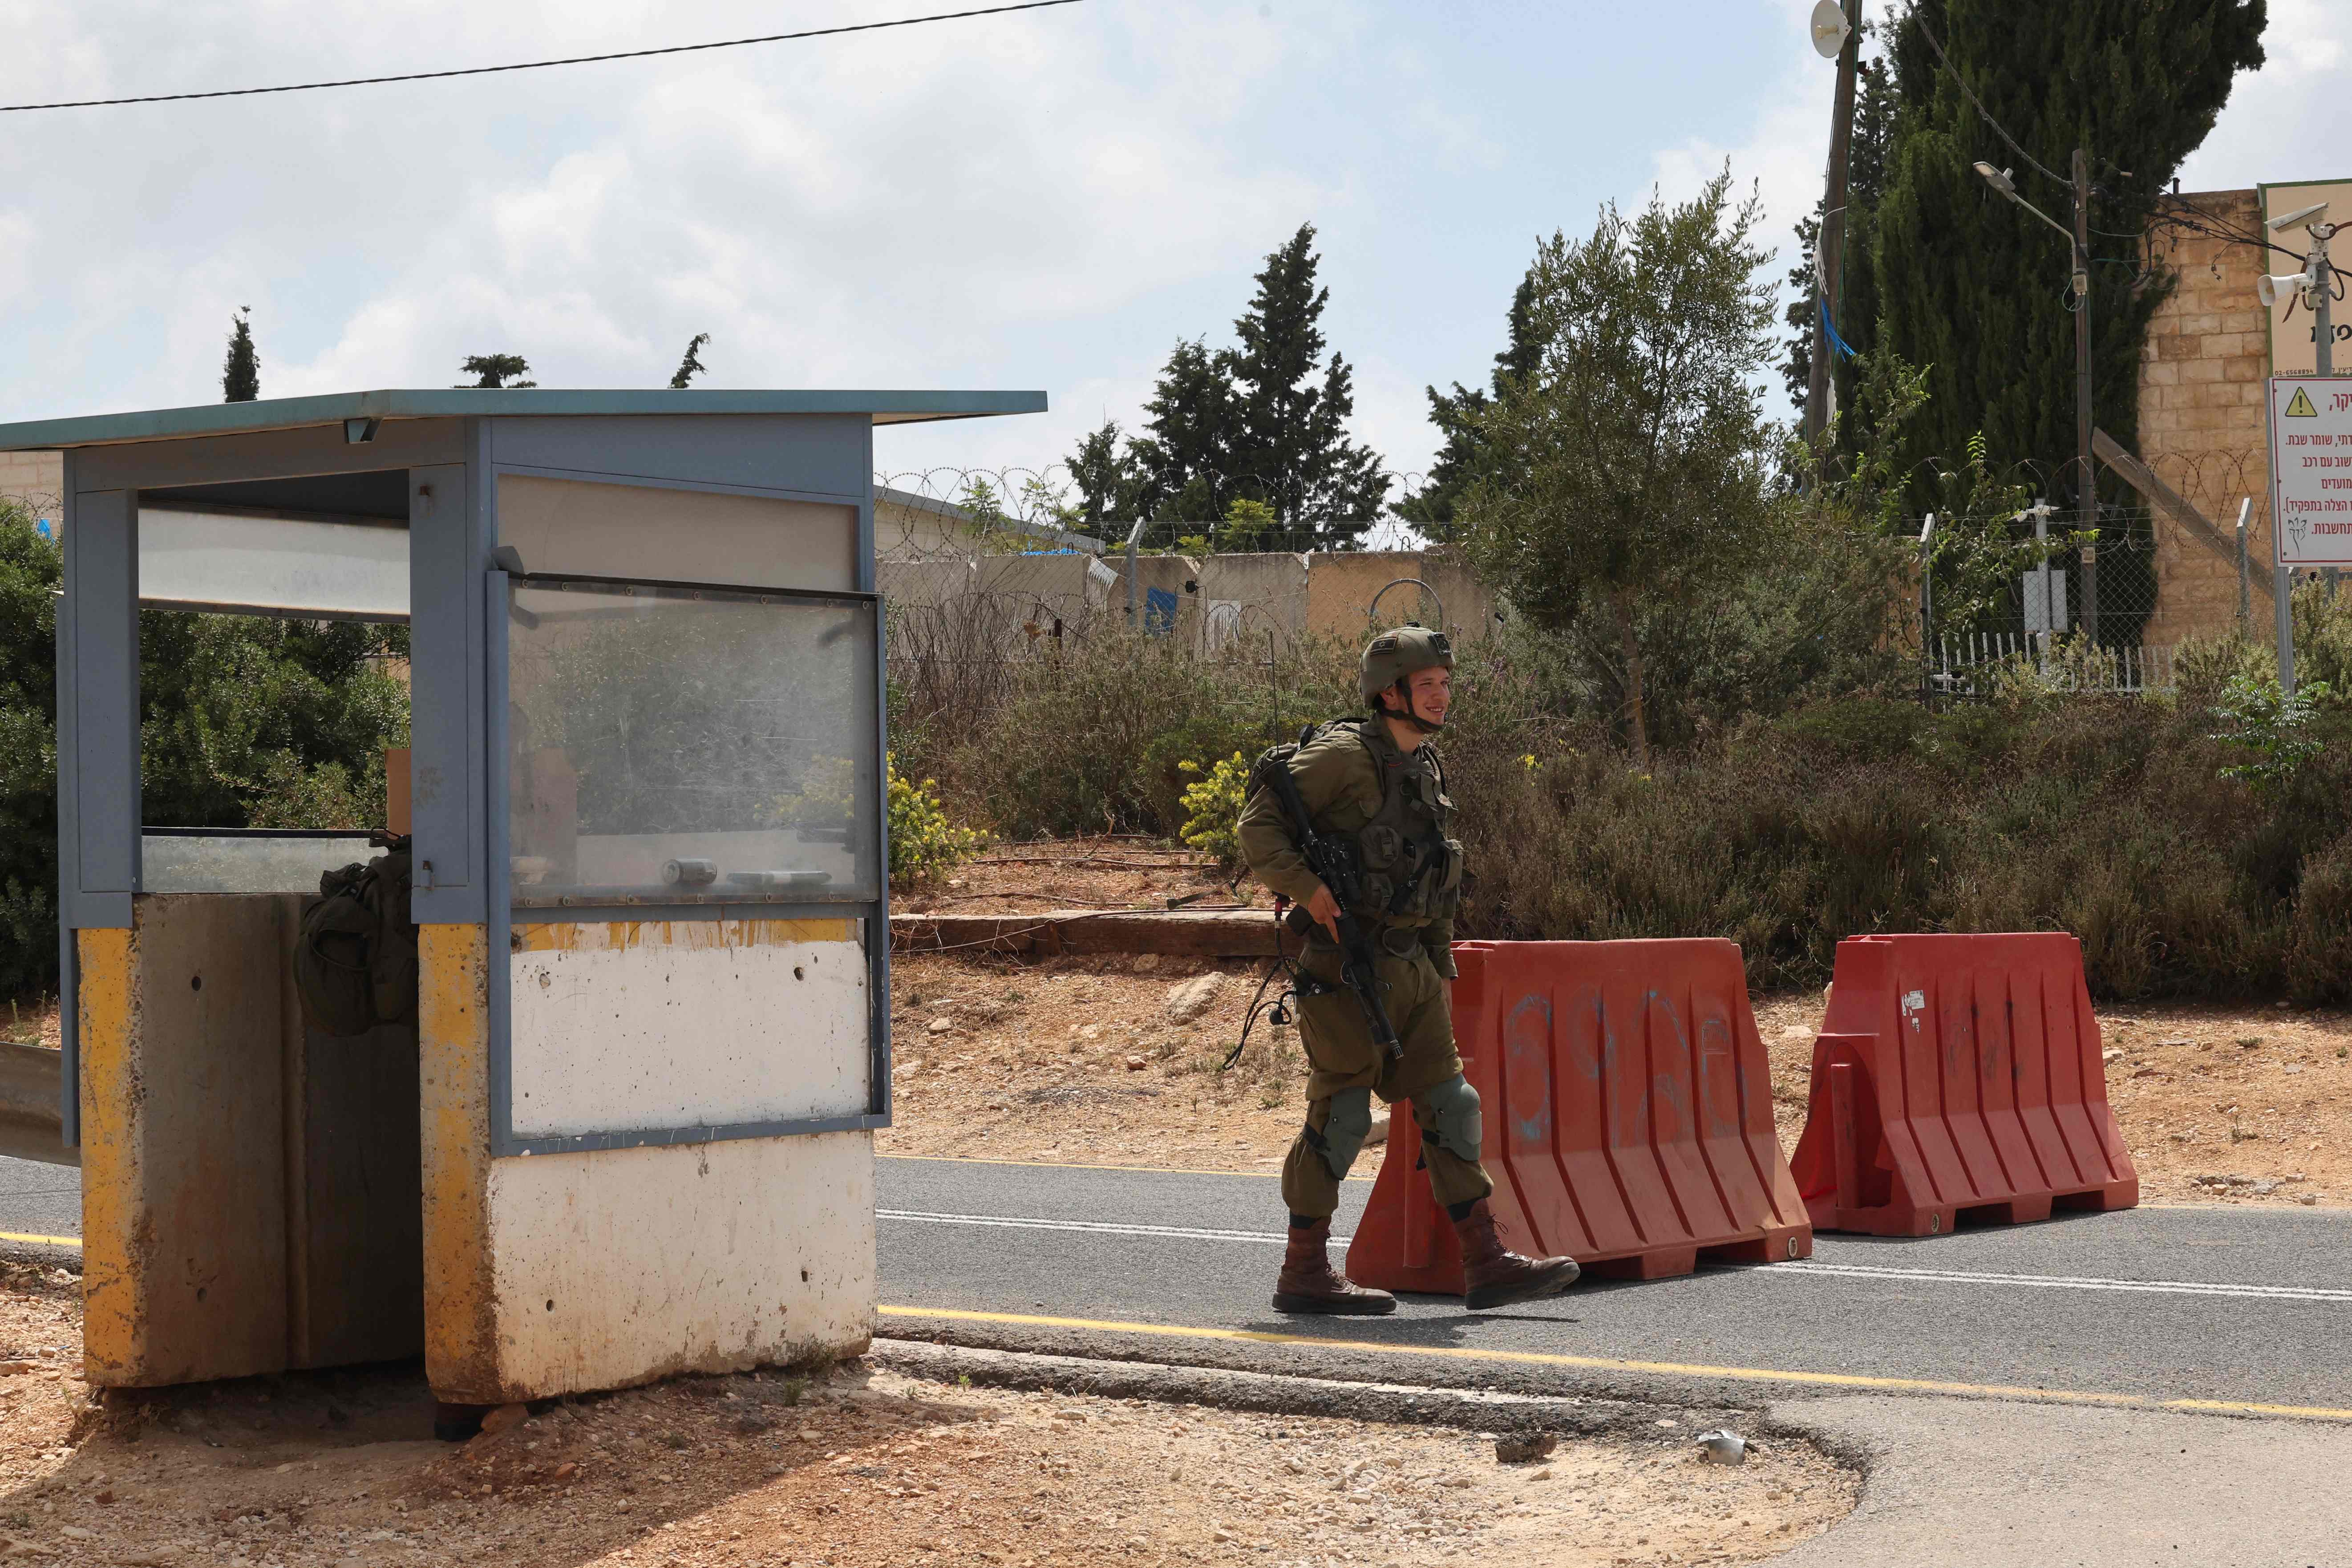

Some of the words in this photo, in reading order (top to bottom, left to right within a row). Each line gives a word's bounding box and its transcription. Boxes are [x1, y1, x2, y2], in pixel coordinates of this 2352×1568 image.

[2285, 434, 2307, 445] שבת.
[2310, 435, 2332, 445] שומר
[2302, 457, 2317, 467] רכב
[2320, 457, 2332, 467] עם
[2334, 456, 2352, 467] שוב
[2283, 496, 2322, 514] בתפקיד).
[2325, 498, 2348, 511] הצלה
